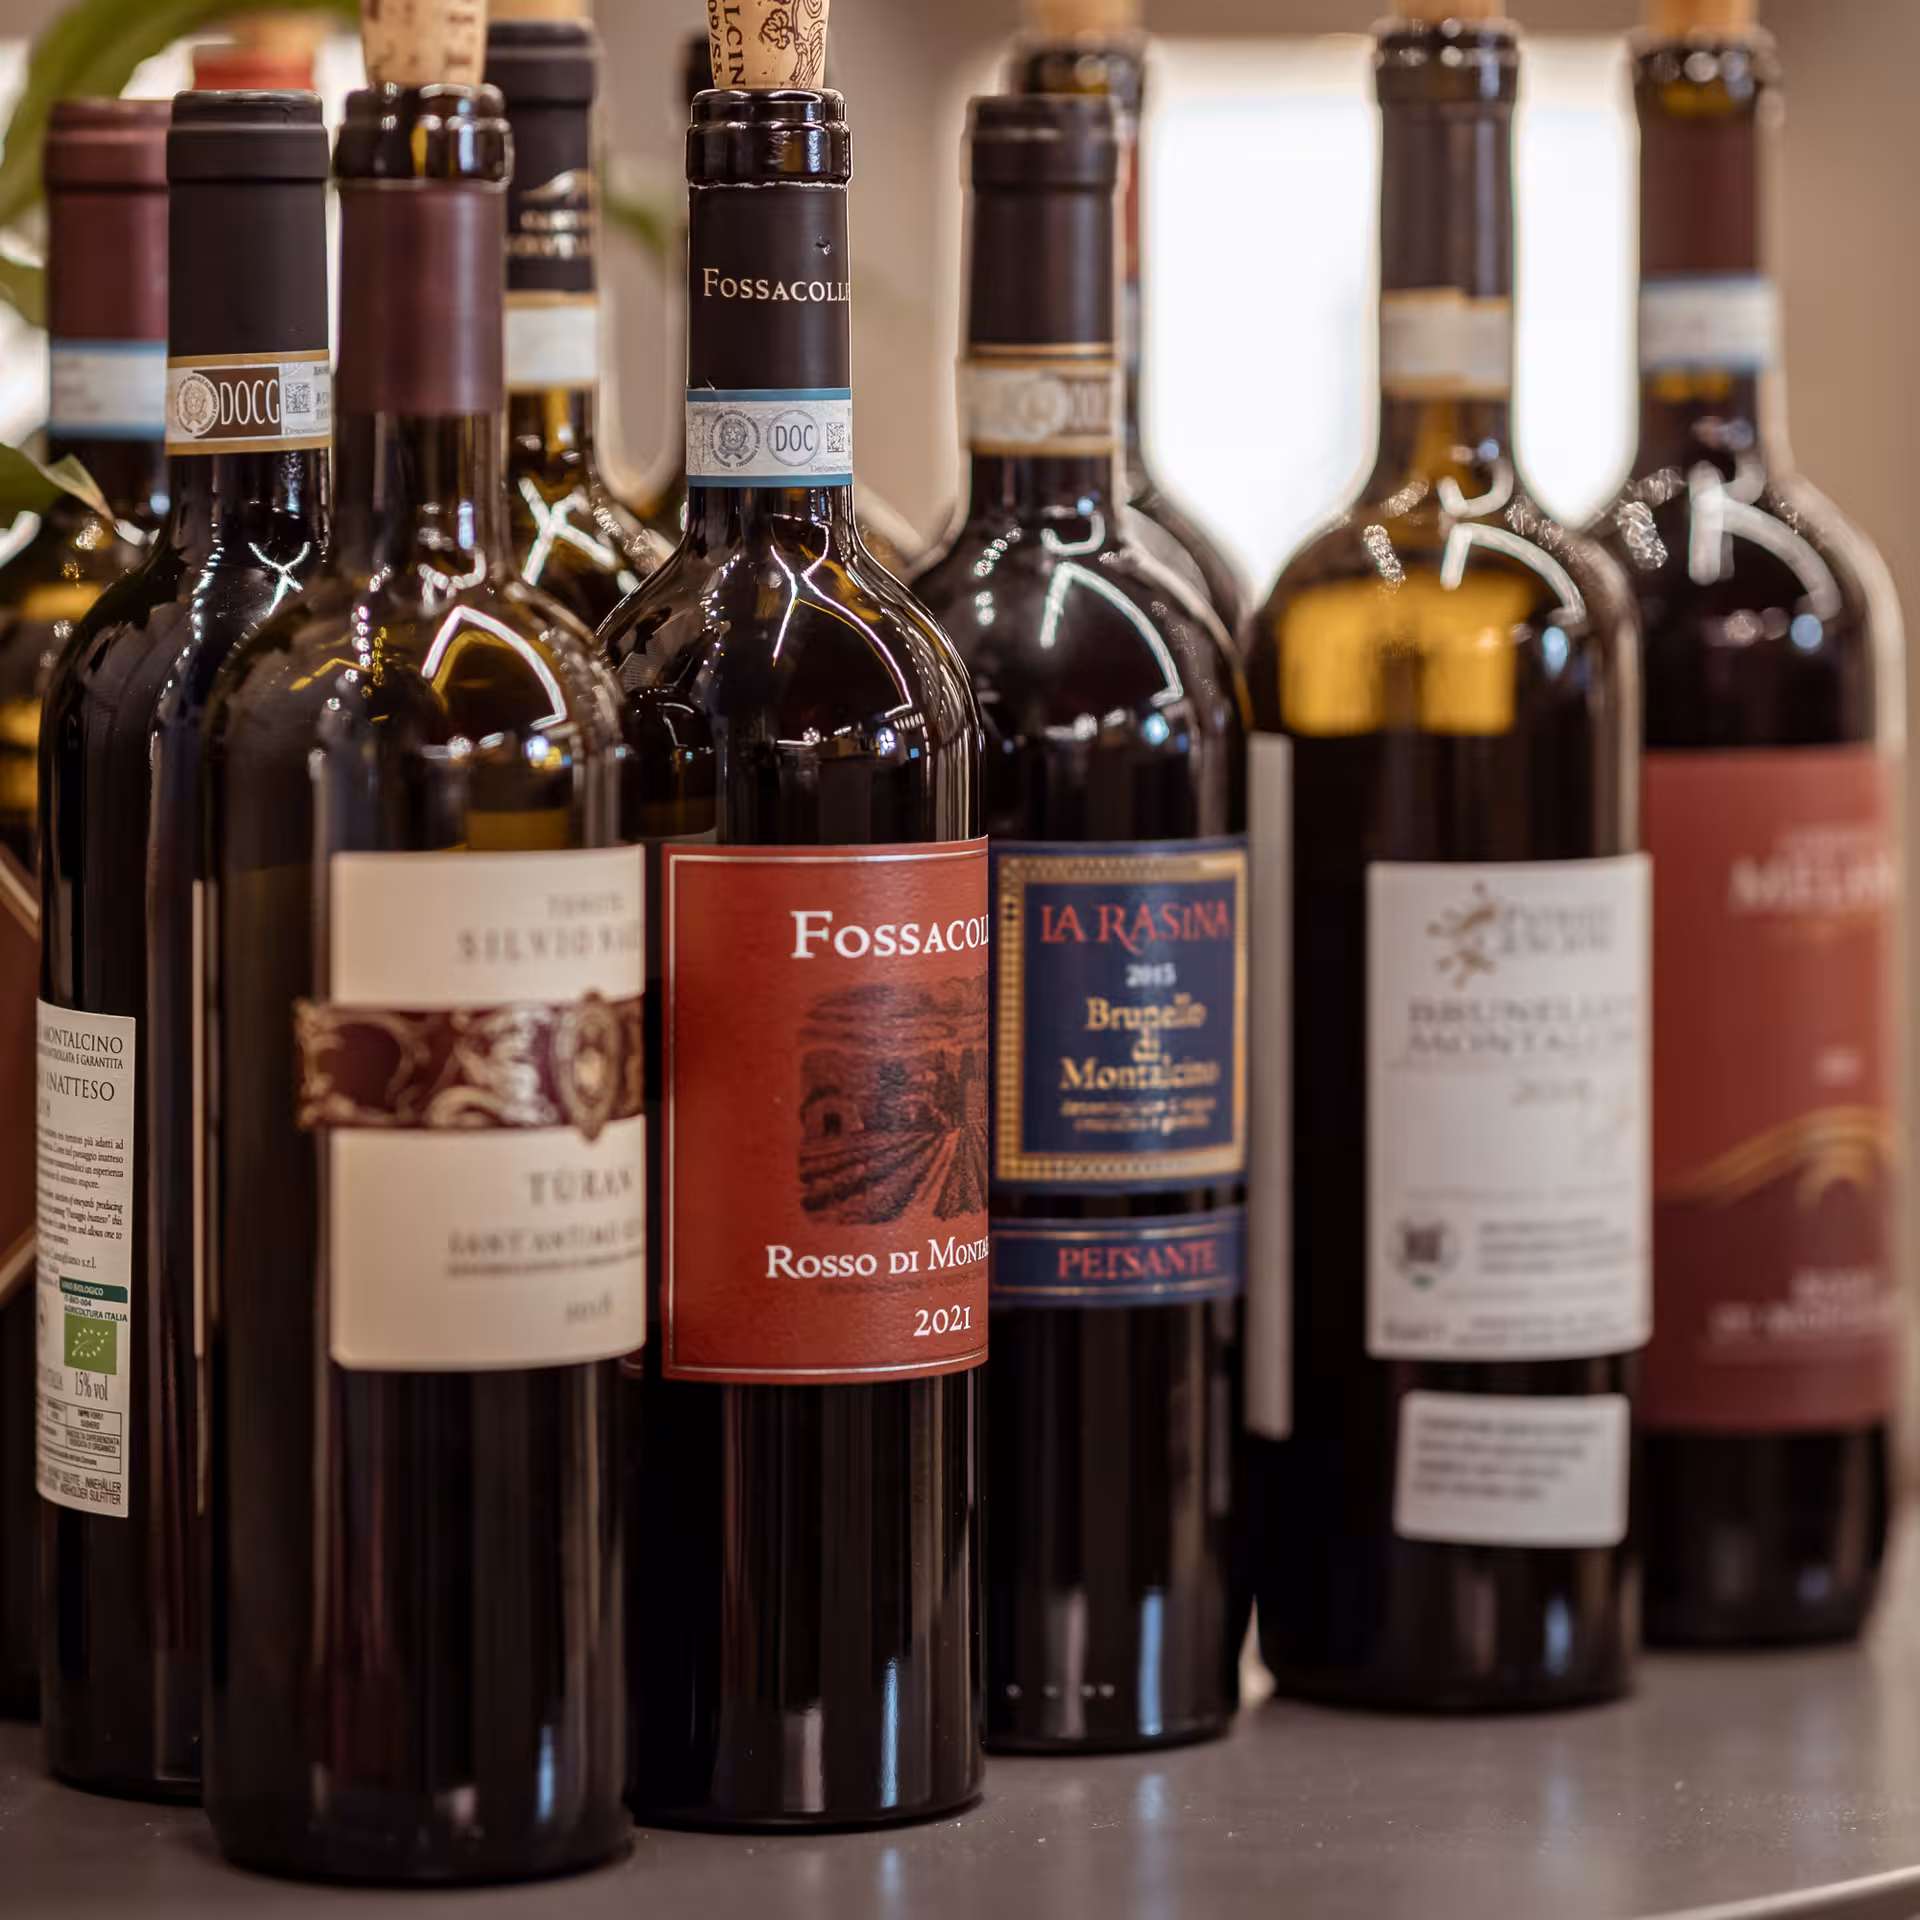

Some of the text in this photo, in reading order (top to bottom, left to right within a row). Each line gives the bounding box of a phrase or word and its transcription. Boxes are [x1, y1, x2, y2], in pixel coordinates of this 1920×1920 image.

[219, 379, 280, 426] DOCG
[775, 424, 814, 452] DOC
[1040, 900, 1231, 956] LA RASINA
[80, 1054, 123, 1070] GARANTITA
[46, 1071, 115, 1102] INATTESO
[115, 1138, 124, 1150] ad
[765, 1244, 877, 1279] ROSSO
[889, 1251, 919, 1274] DI
[104, 1311, 128, 1322] ITALIA
[913, 1304, 971, 1337] 2021
[75, 1371, 92, 1398] 15%
[93, 1375, 108, 1401] vol
